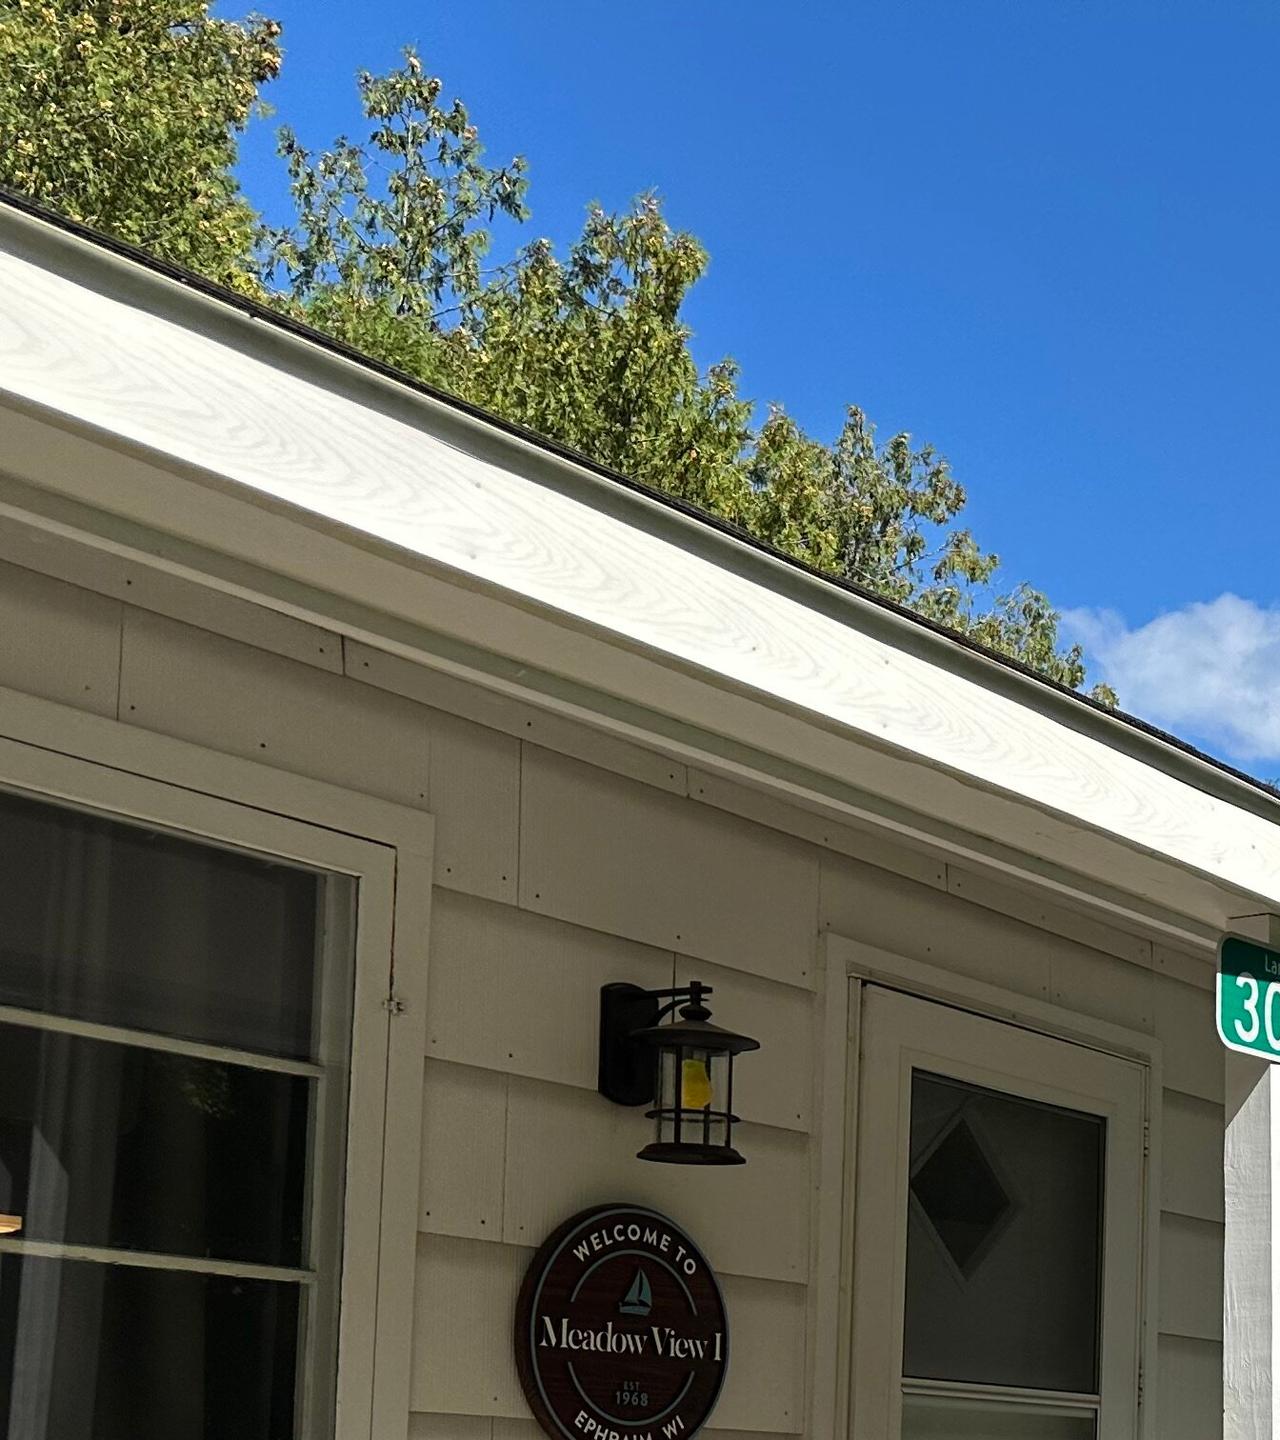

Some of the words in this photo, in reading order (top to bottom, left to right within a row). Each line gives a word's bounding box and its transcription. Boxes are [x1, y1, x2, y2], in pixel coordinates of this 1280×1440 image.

[573, 1224, 672, 1263] WELCOME
[675, 1246, 697, 1275] TO
[541, 1316, 648, 1355] Meadow
[651, 1326, 708, 1360] View
[714, 1332, 722, 1361] I
[623, 1380, 640, 1391] EST
[616, 1391, 649, 1407] 1968
[662, 1415, 685, 1440] WI
